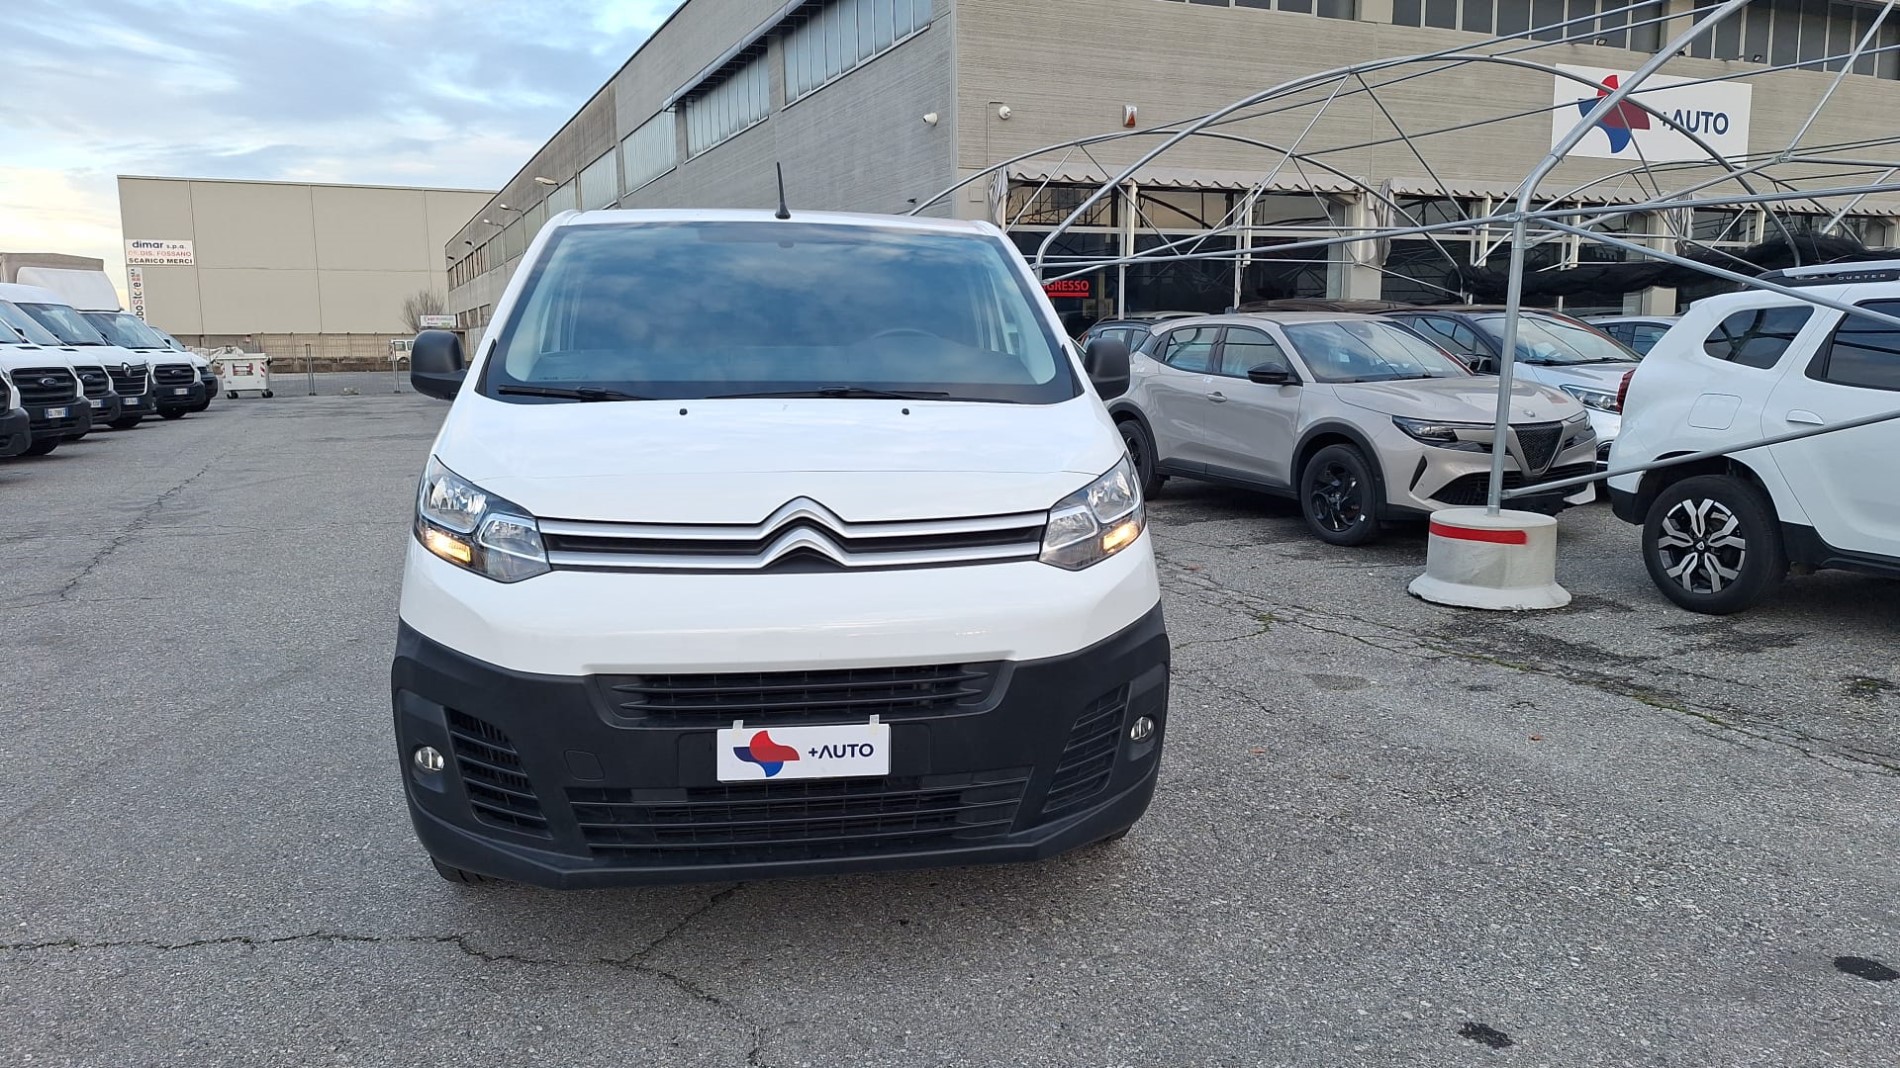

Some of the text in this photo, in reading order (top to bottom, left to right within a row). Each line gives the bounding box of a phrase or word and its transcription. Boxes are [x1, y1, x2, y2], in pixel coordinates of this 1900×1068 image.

[132, 241, 164, 249] dimar
[1044, 280, 1089, 291] GRESSO
[808, 743, 874, 759] +AUTO
